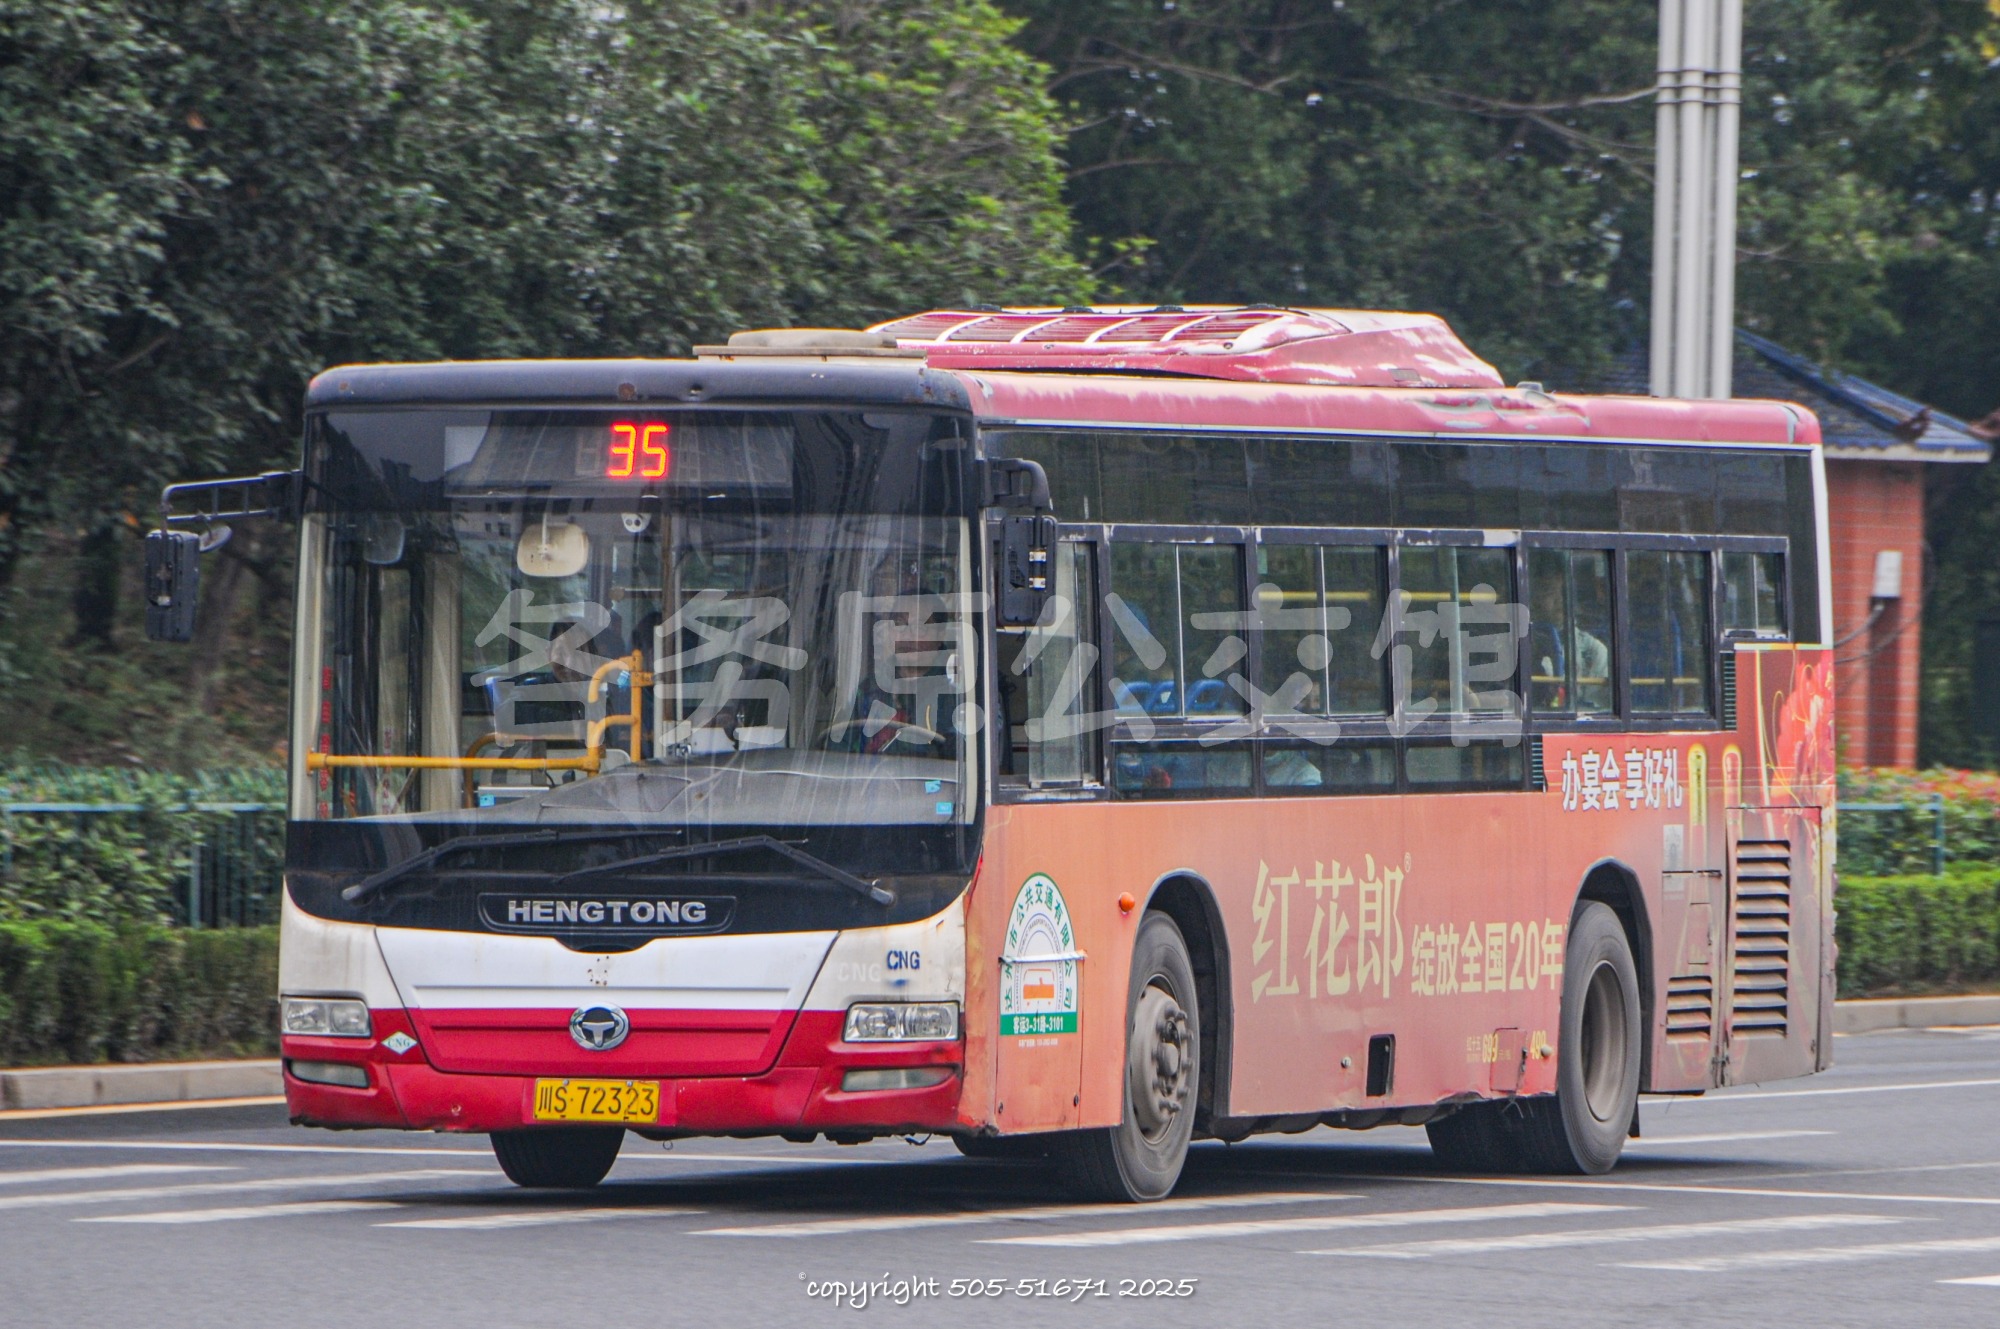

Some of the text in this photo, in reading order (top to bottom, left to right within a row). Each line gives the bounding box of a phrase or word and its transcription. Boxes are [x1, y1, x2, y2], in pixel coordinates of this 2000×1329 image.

[607, 422, 669, 479] 35
[508, 900, 707, 924] HENGTONG
[887, 950, 920, 970] CNG
[838, 962, 881, 982] CNG
[387, 1037, 411, 1047] CNG
